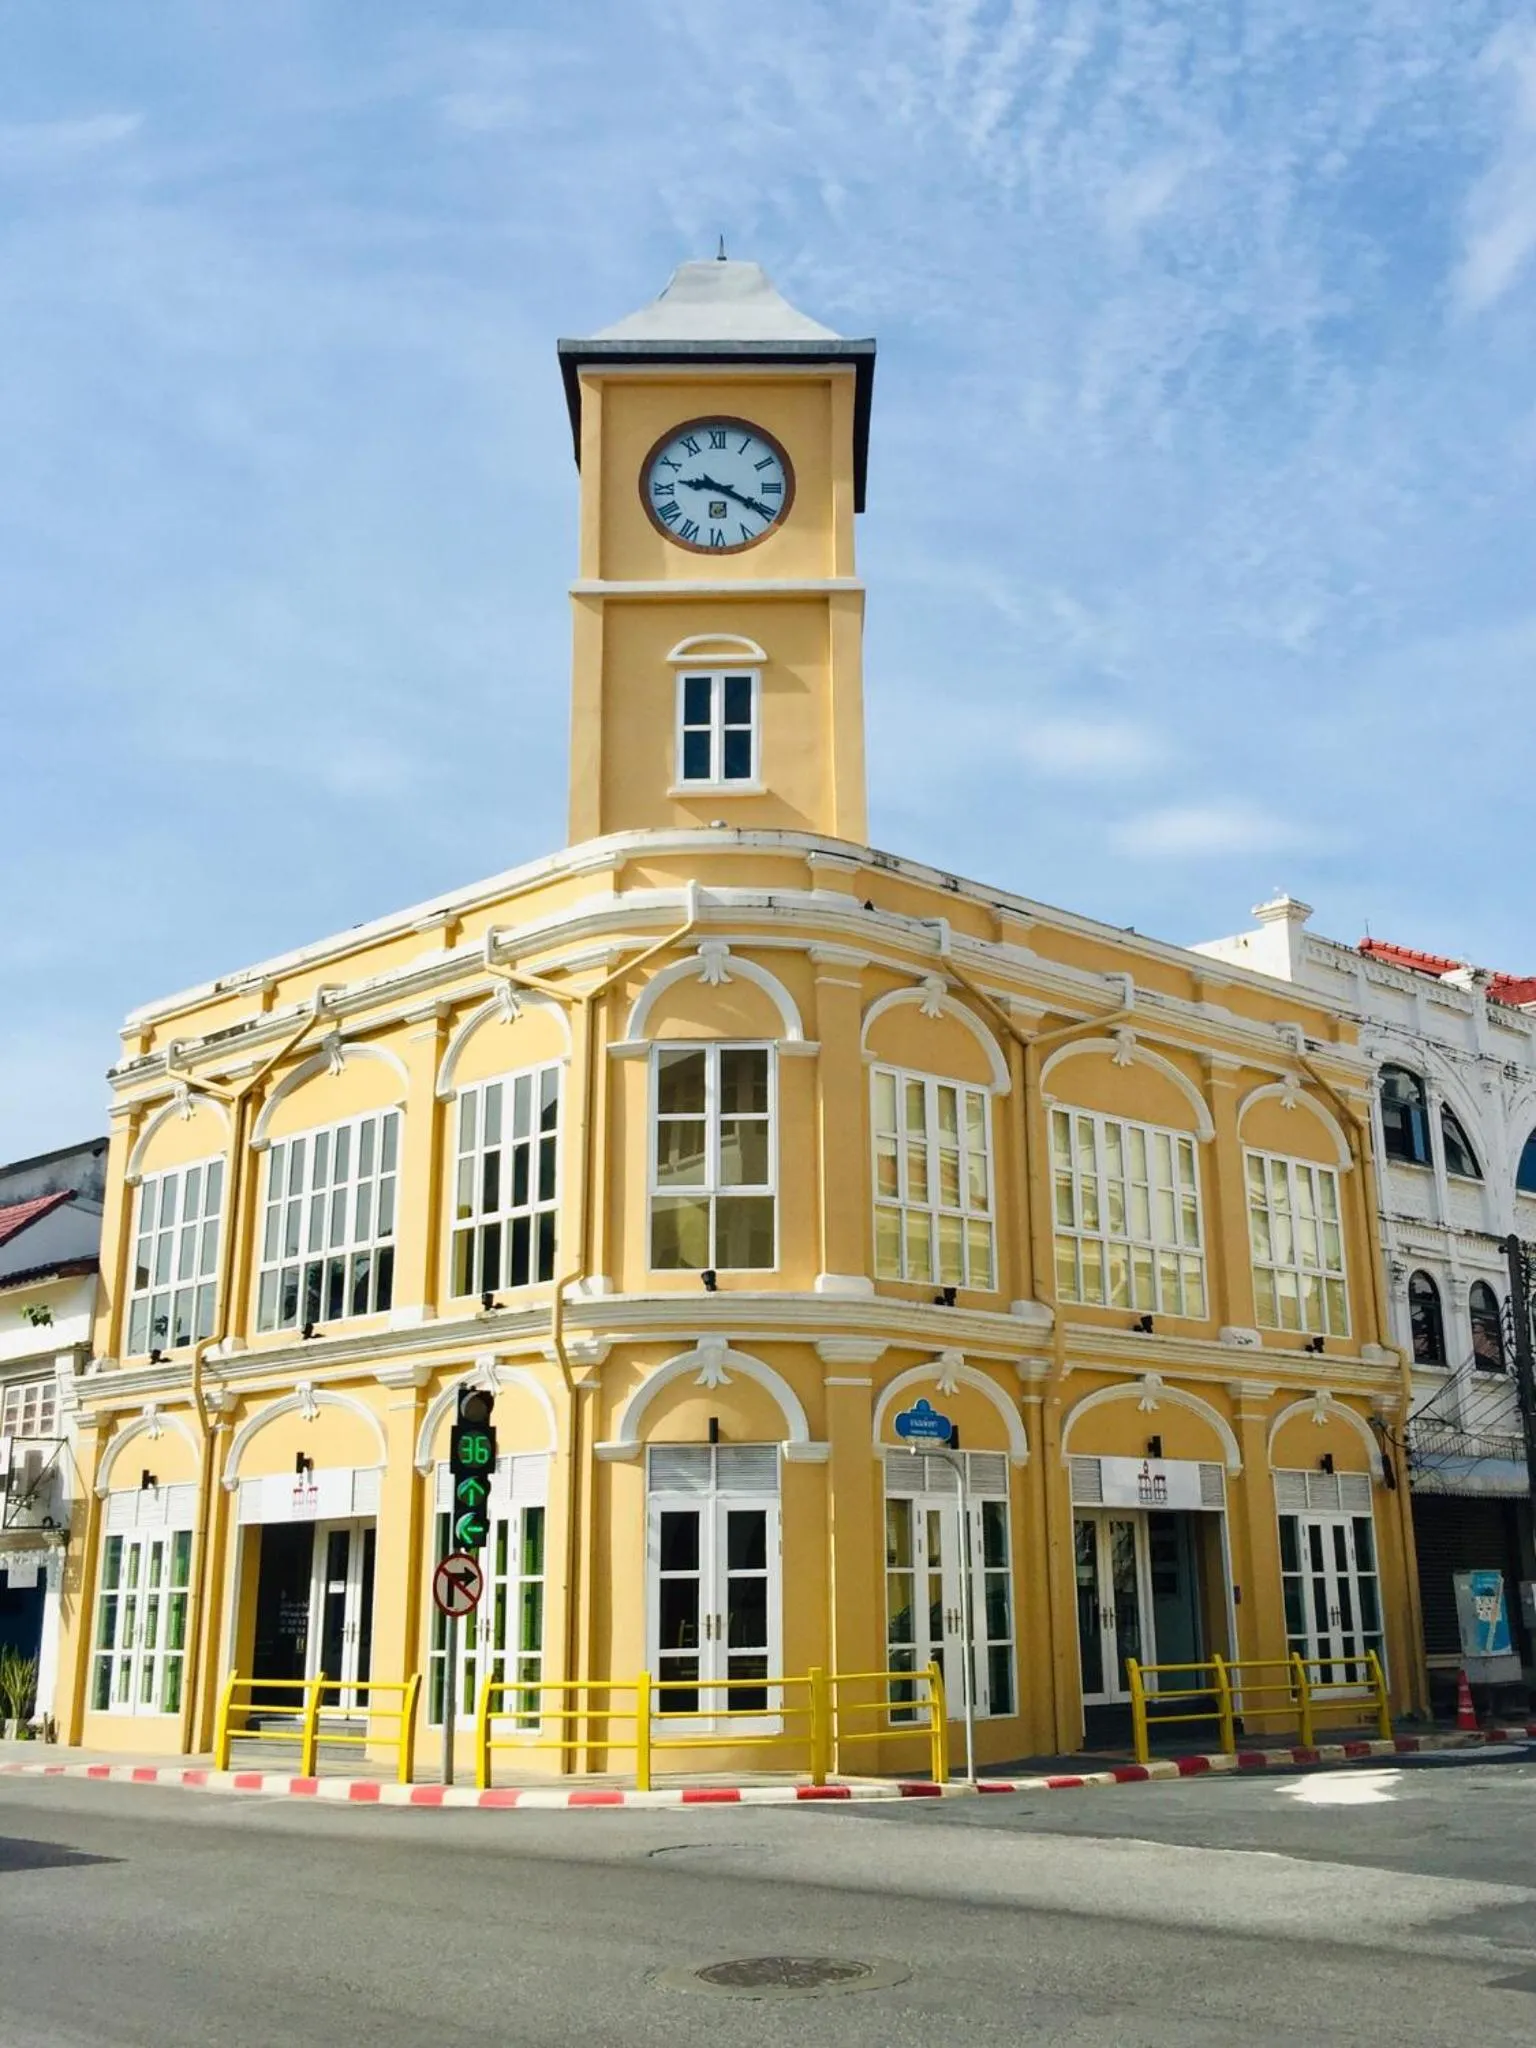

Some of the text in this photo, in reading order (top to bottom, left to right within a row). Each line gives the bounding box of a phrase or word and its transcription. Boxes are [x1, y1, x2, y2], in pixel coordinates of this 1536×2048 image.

[680, 437, 702, 457] XI
[708, 431, 727, 449] XII
[738, 437, 752, 455] I
[660, 455, 682, 473] X
[754, 456, 775, 471] II
[654, 482, 675, 496] IX
[761, 482, 782, 494] III
[658, 500, 682, 526] VIII
[679, 519, 700, 543] VII
[710, 528, 726, 546] VI
[739, 522, 755, 540] V
[461, 1436, 489, 1464] 36
